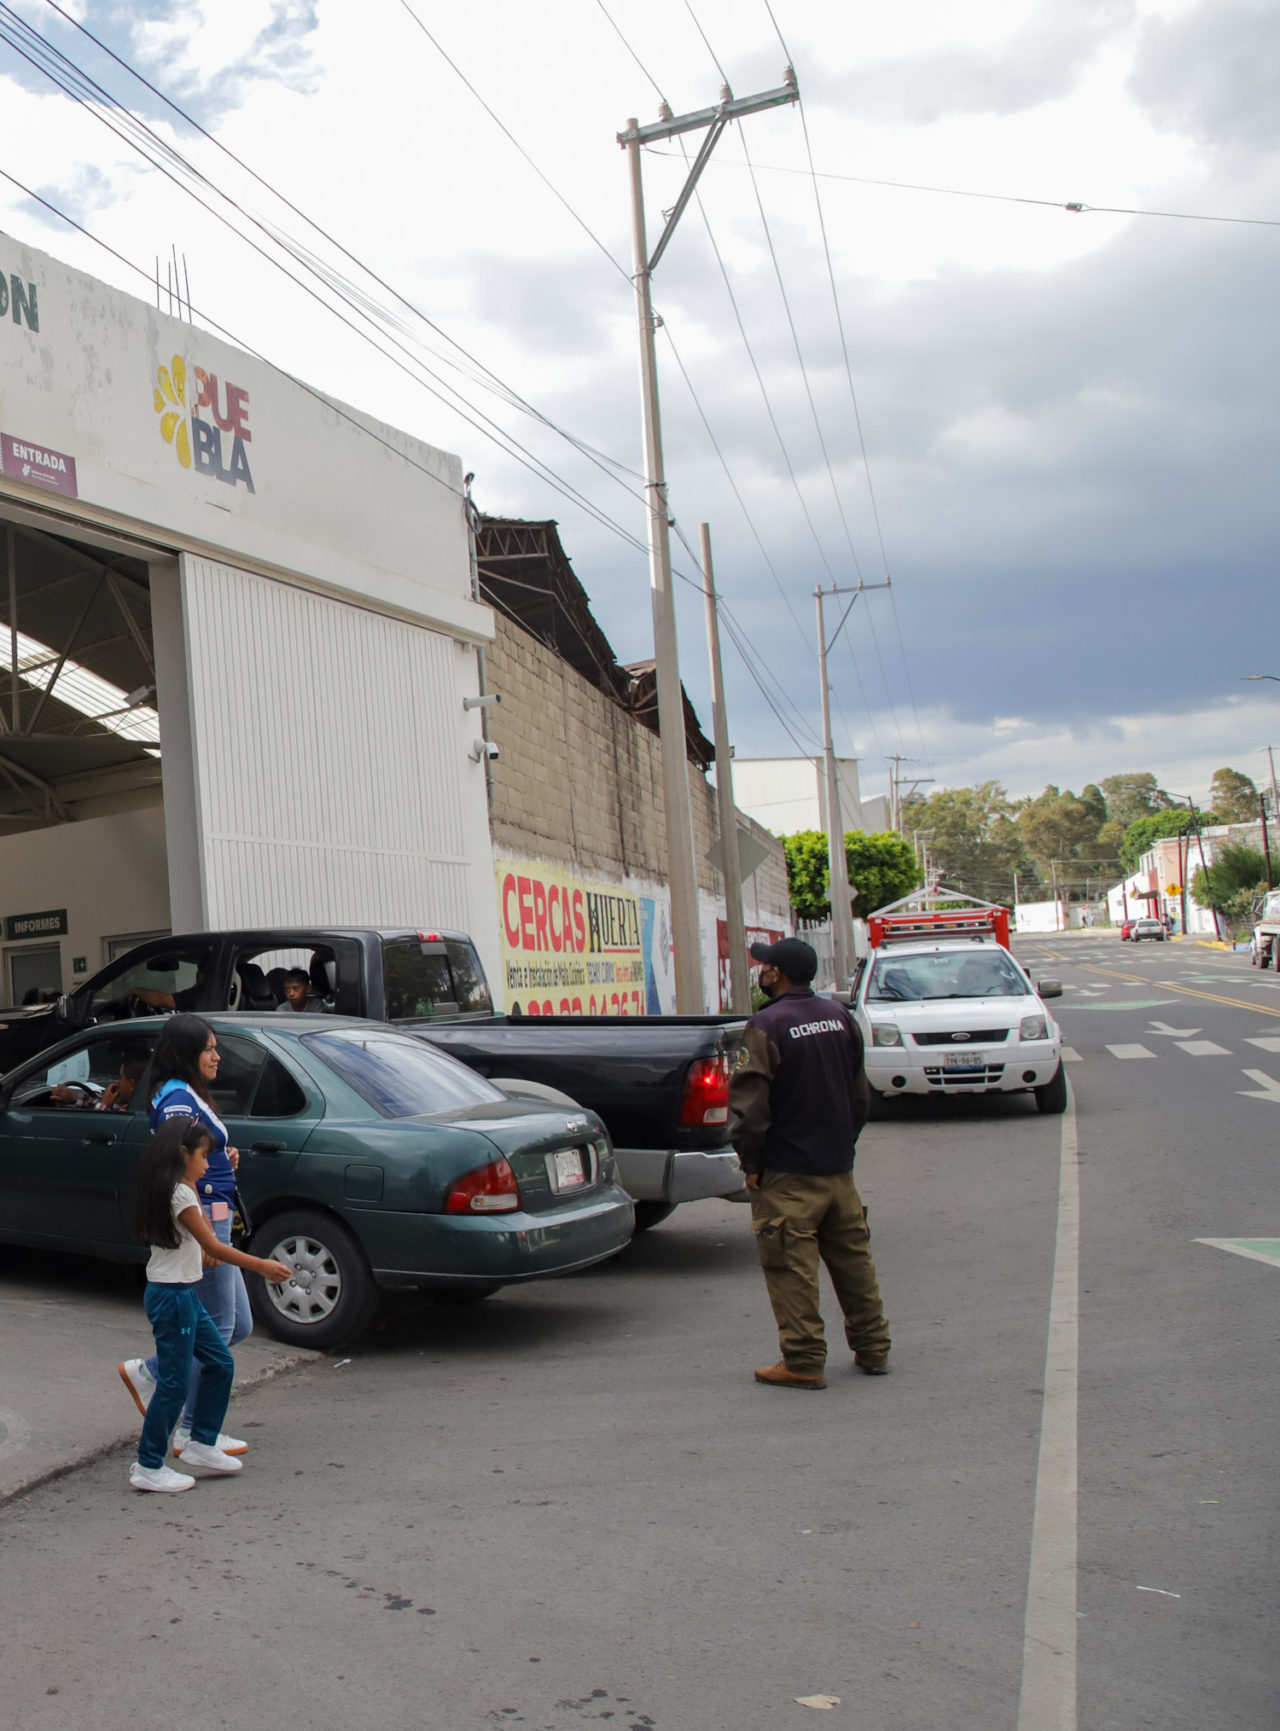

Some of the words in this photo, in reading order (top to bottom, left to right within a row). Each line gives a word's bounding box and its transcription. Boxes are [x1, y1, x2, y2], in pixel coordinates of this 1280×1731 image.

[190, 363, 251, 443] PUE
[12, 442, 66, 473] ENTRADA
[191, 416, 256, 494] BLA
[14, 916, 61, 934] INFORMES
[502, 873, 586, 953] CERCAS
[586, 892, 641, 953] HUERTA
[790, 1020, 845, 1040] OCHRONA
